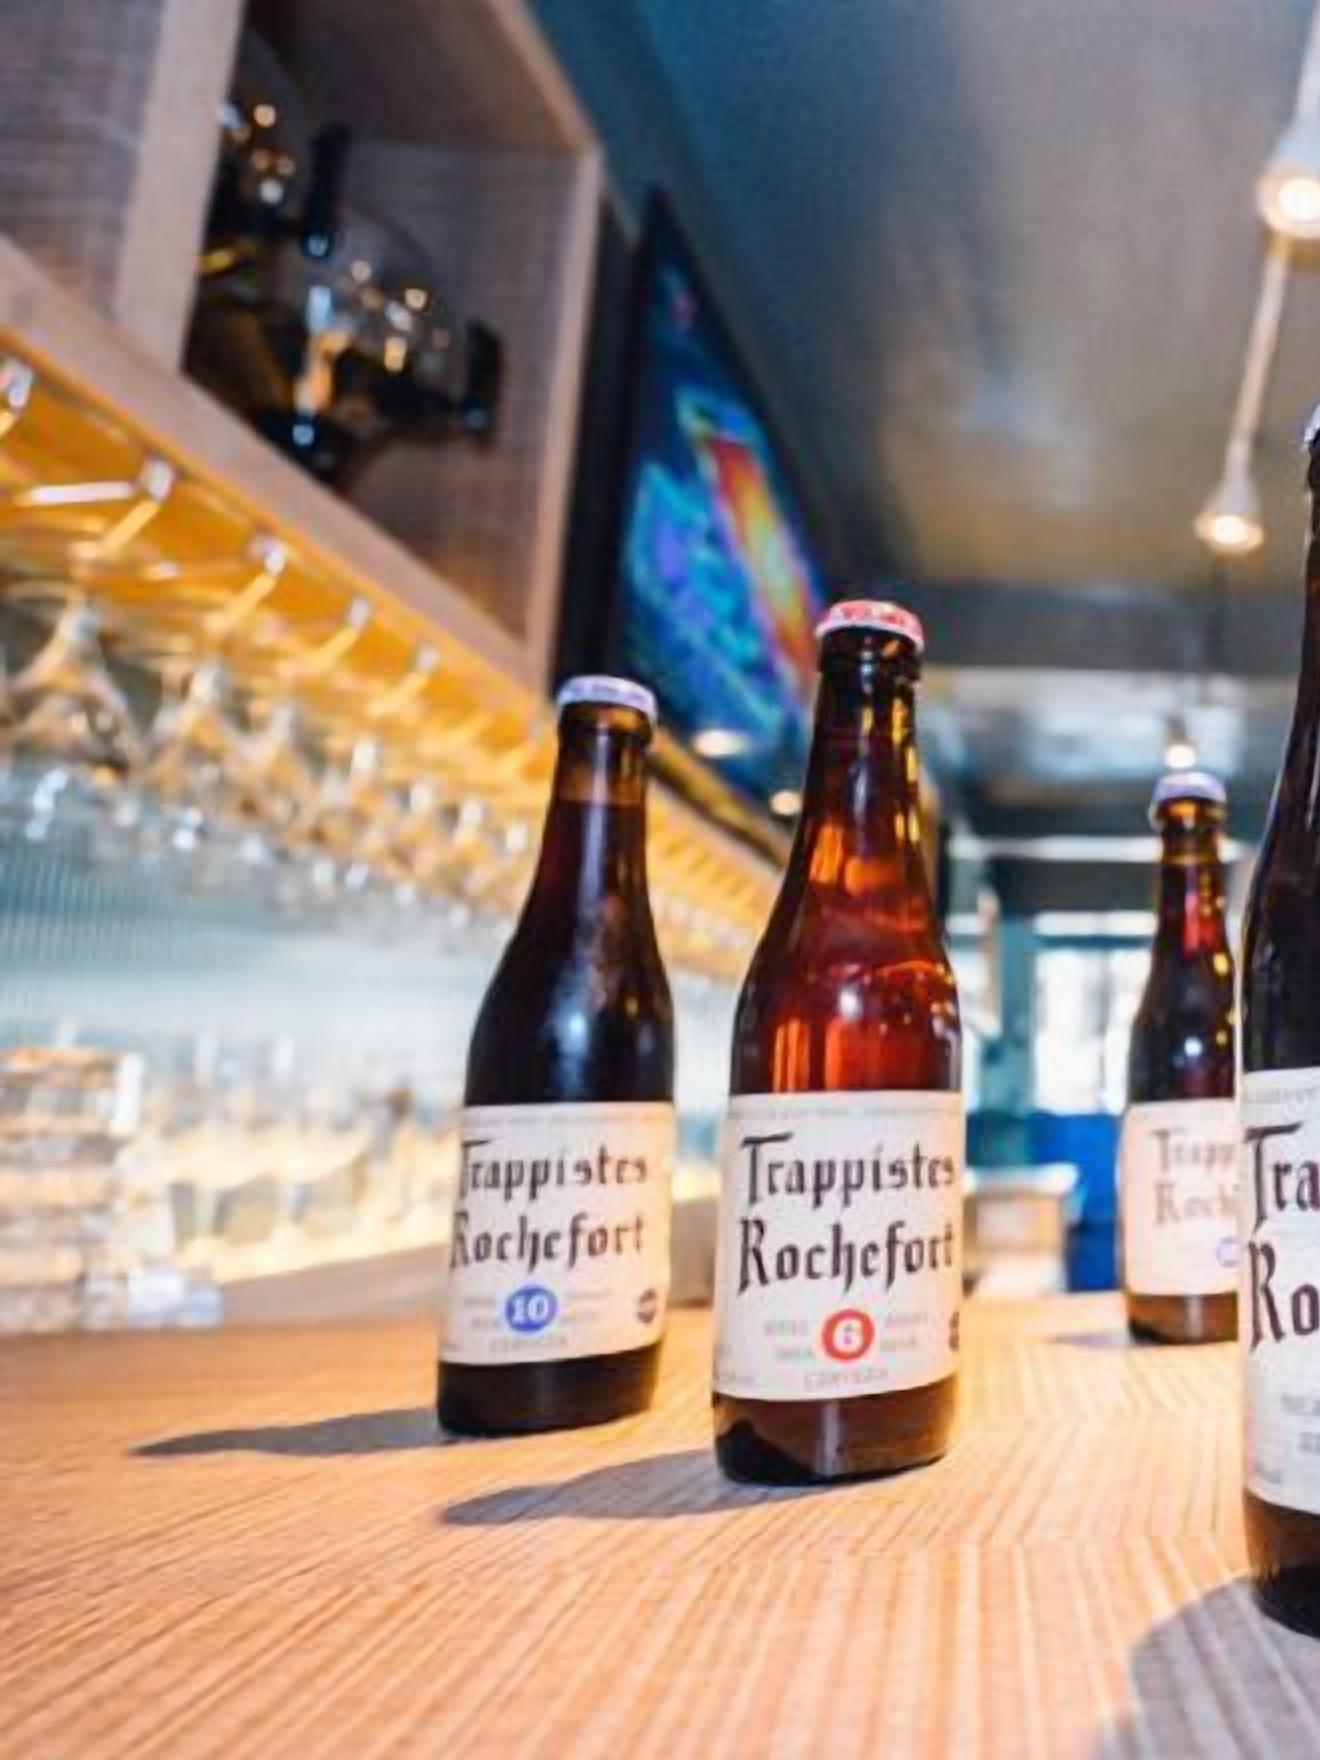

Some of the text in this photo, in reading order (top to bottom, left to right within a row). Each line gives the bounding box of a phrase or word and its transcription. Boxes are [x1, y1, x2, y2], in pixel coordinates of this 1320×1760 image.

[460, 1136, 648, 1203] Trappistes
[740, 1131, 955, 1209] Trappistes
[449, 1208, 645, 1273] Rochefort
[737, 1218, 954, 1295] Rochefort
[509, 1292, 547, 1324] 10
